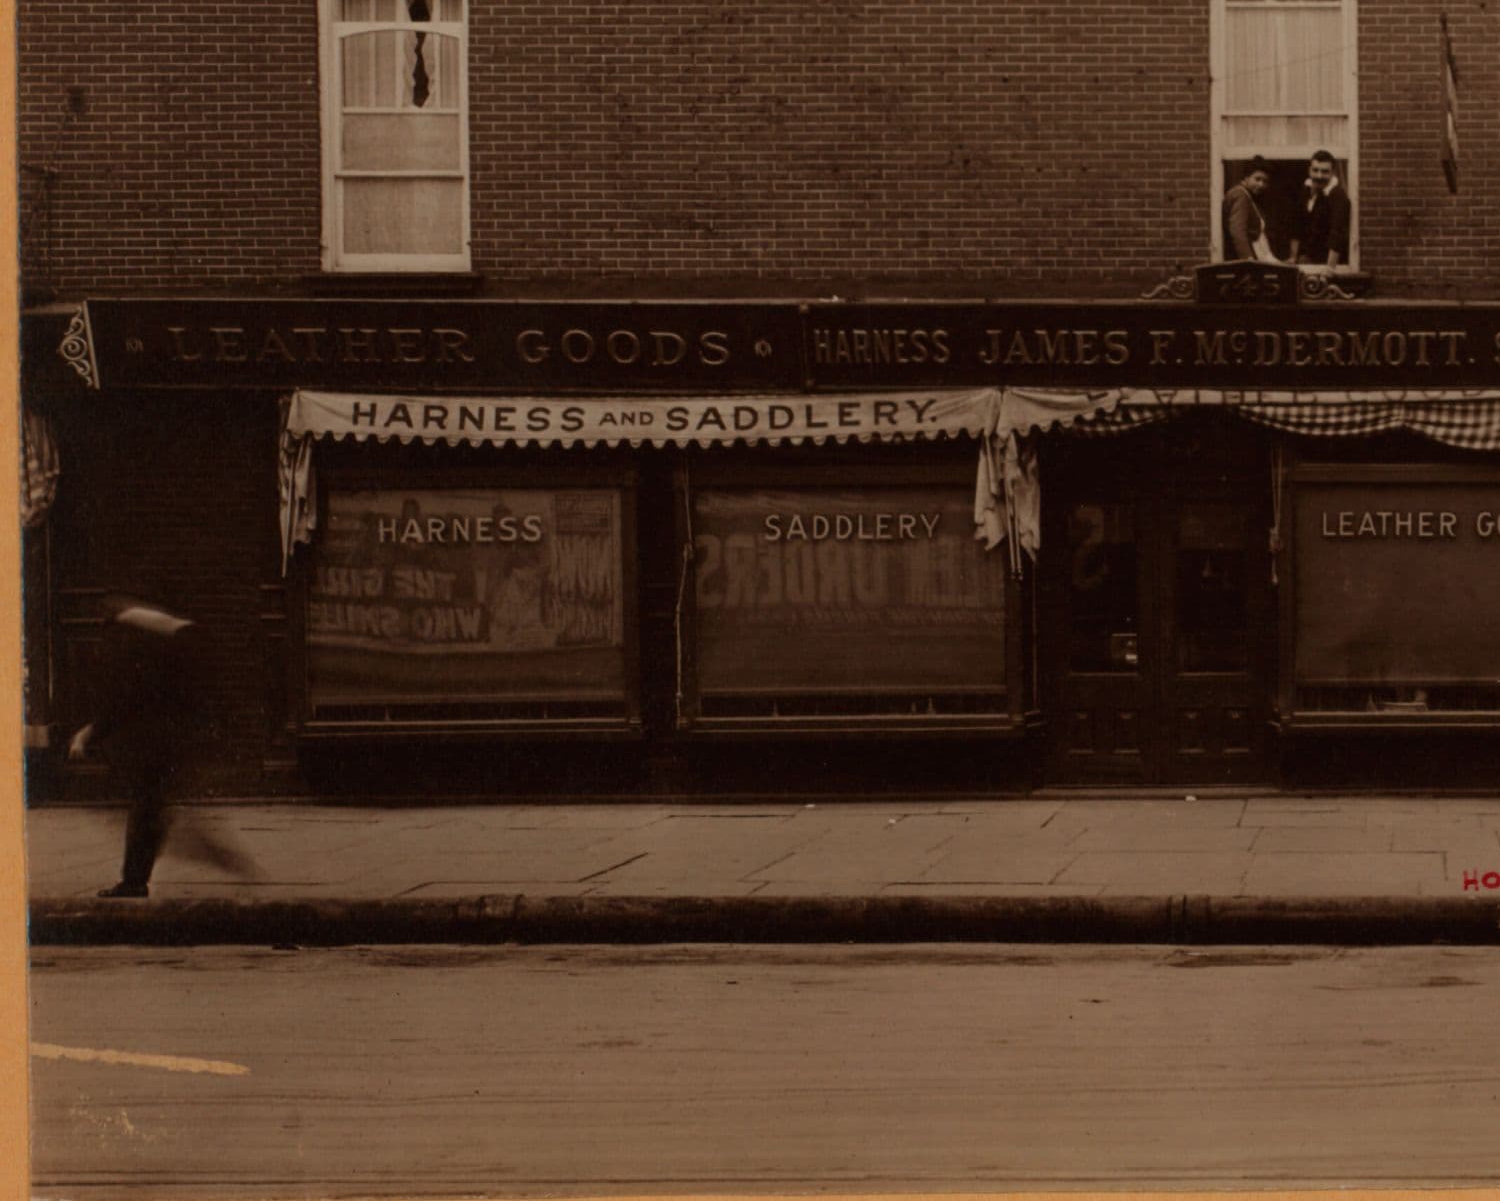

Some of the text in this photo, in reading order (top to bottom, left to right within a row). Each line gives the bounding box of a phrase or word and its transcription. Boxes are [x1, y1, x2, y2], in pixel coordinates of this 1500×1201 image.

[168, 327, 730, 366] LEATHER GOODS
[813, 329, 951, 365] HARNESS
[979, 330, 1129, 366] JAMES
[351, 401, 585, 432] HARNESS
[599, 410, 655, 427] AND
[378, 515, 543, 543] HARNESS
[764, 514, 940, 541] SADDLERY
[1321, 511, 1457, 538] LEATHER
